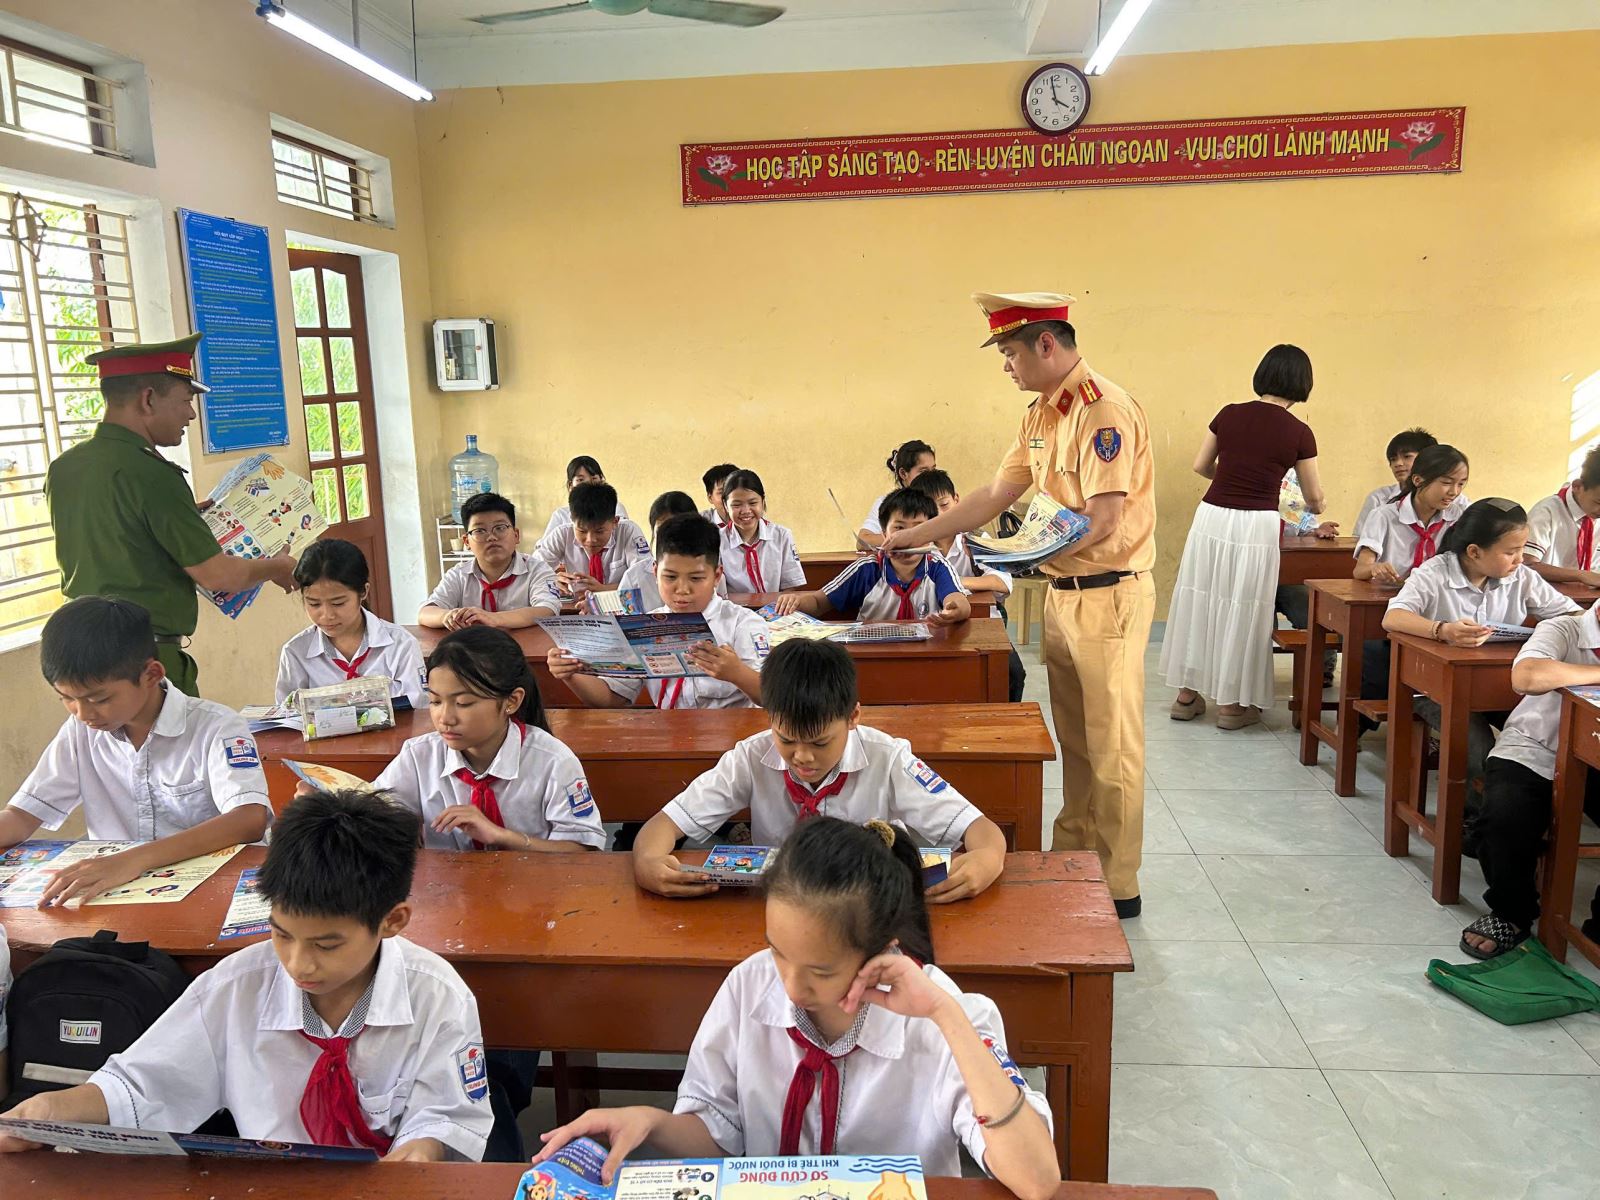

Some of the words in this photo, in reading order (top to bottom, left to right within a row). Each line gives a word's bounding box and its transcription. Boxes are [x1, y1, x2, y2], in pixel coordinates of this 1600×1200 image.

[746, 156, 783, 188] HỌC
[788, 149, 823, 187] TẬP
[828, 146, 878, 178] SÁNG
[883, 149, 920, 182] TẠO
[936, 142, 970, 172] RÈN
[976, 138, 1035, 177] LUYỆN
[1041, 134, 1095, 168] CHĂM
[1101, 138, 1169, 166] NGOAN
[1185, 136, 1217, 161] VUI
[1223, 131, 1269, 160] CHƠI
[1273, 125, 1325, 158] LÀNH
[1330, 128, 1390, 162] MẠNH
[64, 1024, 98, 1037] YUQUILIN
[822, 1159, 839, 1167] KHI
[740, 1172, 777, 1184] ĐÚNG
[810, 1170, 828, 1182] SƠ
